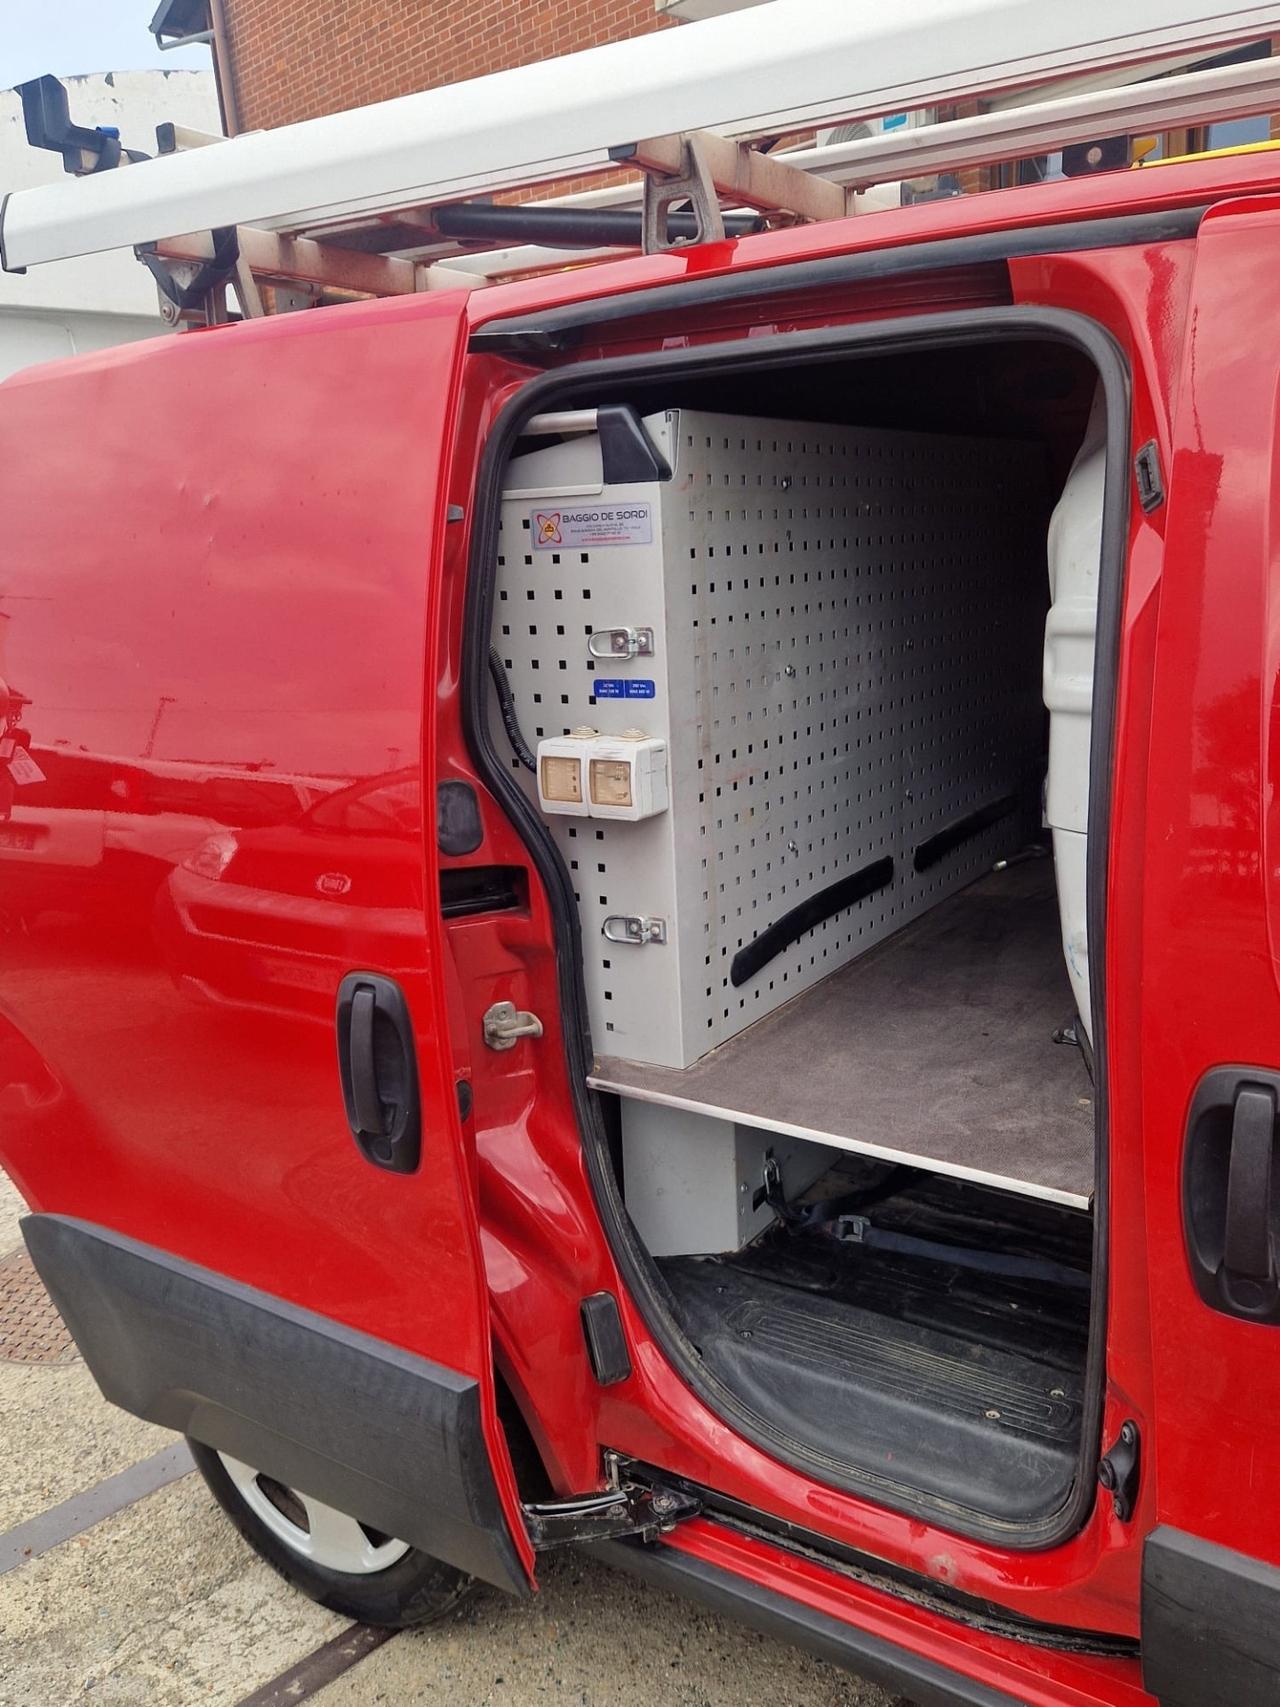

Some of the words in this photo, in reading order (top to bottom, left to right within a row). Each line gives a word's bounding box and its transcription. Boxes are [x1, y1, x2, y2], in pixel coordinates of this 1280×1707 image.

[562, 513, 599, 523] BAGGIO
[601, 512, 614, 521] DE
[616, 509, 648, 520] SORDI
